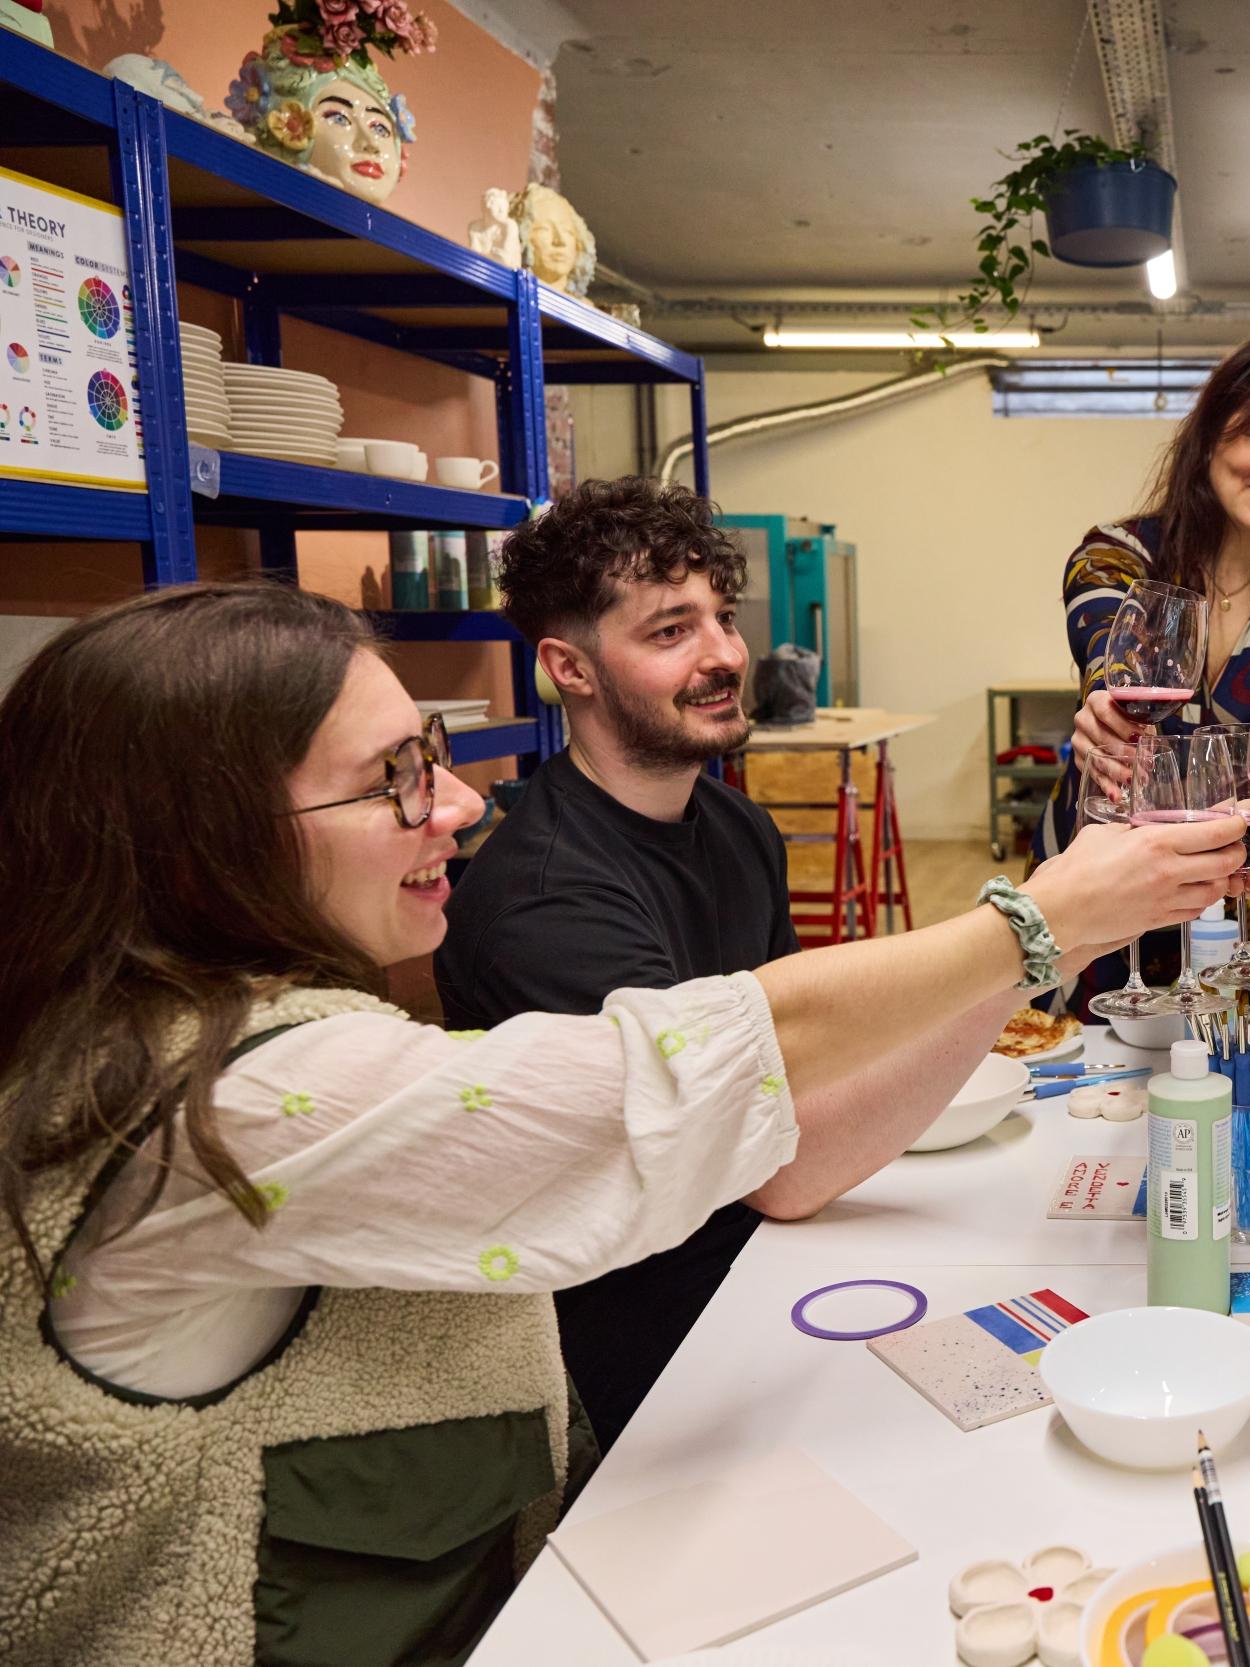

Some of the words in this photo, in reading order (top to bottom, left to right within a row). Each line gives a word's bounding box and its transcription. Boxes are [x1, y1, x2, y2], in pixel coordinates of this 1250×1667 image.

[7, 206, 65, 238] THEORY
[28, 241, 64, 259] MEANINGS
[74, 255, 99, 270] COLOR
[1177, 1129, 1191, 1139] AP
[1064, 1162, 1088, 1197] AMORE
[1081, 1162, 1111, 1210] VENDETTA
